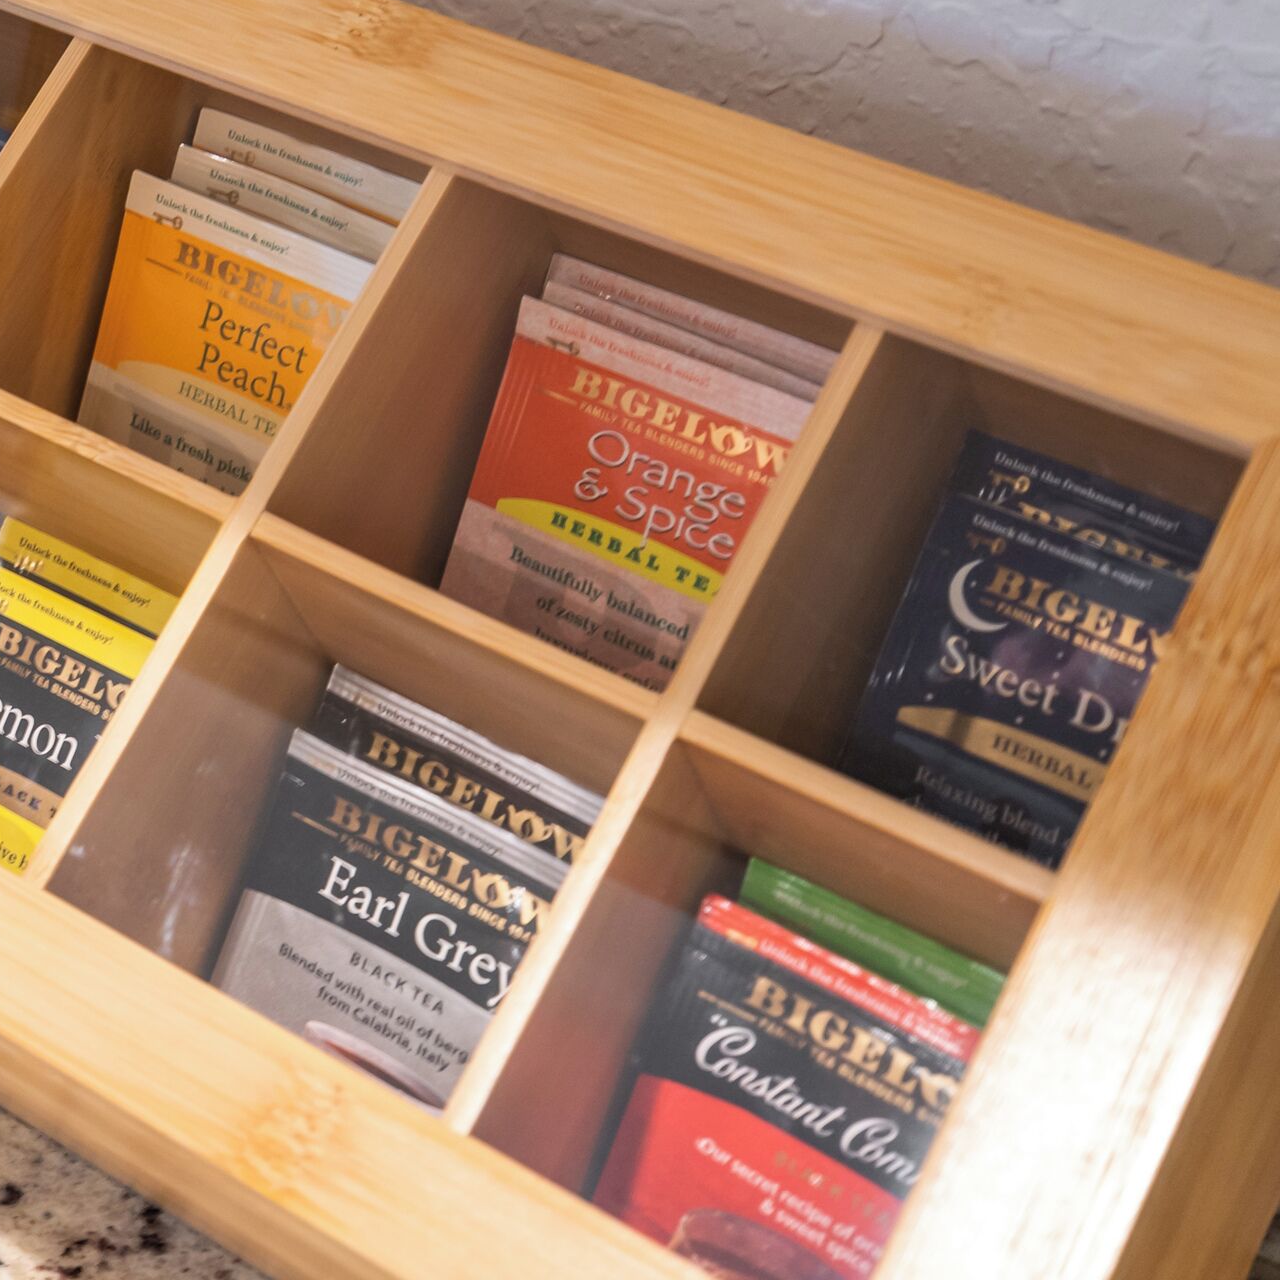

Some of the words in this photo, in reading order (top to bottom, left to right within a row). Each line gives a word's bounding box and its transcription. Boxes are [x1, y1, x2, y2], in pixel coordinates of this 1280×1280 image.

[228, 129, 262, 149] Unlock
[263, 142, 278, 155] the
[279, 147, 325, 172] freshness
[324, 166, 332, 175] &
[334, 171, 364, 187] enjoy!
[155, 193, 189, 213] Unlock
[190, 207, 204, 221] the
[205, 214, 250, 241] freshness
[250, 233, 258, 242] &
[260, 238, 290, 255] enjoy!
[209, 169, 245, 189] Unlock
[247, 183, 263, 195] the
[265, 188, 310, 215] freshness
[310, 208, 318, 218] &
[320, 214, 349, 231] enjoy!
[199, 299, 308, 374] Perfect
[178, 381, 248, 425] HERBAL
[129, 413, 161, 441] Like
[163, 434, 172, 446] a
[175, 435, 214, 467] fresh
[578, 401, 617, 424] FAMILY
[621, 418, 641, 435] TEA
[644, 428, 706, 461] BLENDERS
[708, 454, 745, 477] SINCE
[587, 430, 746, 524] Orange
[1041, 470, 1061, 486] the
[574, 468, 608, 501] &
[615, 486, 735, 559] Spice
[1016, 531, 1037, 547] the
[19, 536, 52, 559] Unlock
[53, 552, 68, 567] the
[68, 561, 112, 590] freshness
[112, 583, 120, 593] &
[121, 588, 152, 608] enjoy!
[551, 511, 660, 571] HERBAL
[674, 566, 720, 596] TE
[17, 592, 32, 606] the
[32, 599, 75, 627] freshness
[76, 620, 83, 630] &
[85, 626, 115, 645] enjoy!
[510, 545, 604, 602] Beautifully
[606, 591, 690, 642] balanced
[536, 596, 554, 614] of
[555, 606, 599, 637] zesty
[603, 626, 655, 662] citrus
[996, 604, 1044, 630] FAMILY
[1045, 621, 1071, 640] TEA
[1072, 633, 1147, 673] BLENDERS
[0, 657, 32, 679] FAMILY
[32, 674, 49, 689] TEA
[50, 683, 101, 716] BLENDERS
[940, 635, 1060, 715] Sweet
[992, 735, 1092, 790] HERBAL
[914, 765, 998, 819] Relaxing
[998, 805, 1061, 845] blend
[340, 833, 380, 861] FAMILY
[383, 854, 404, 875] TEA
[405, 868, 468, 910] BLENDERS
[469, 902, 507, 931] SINCE
[318, 855, 410, 938] Earl
[414, 913, 513, 1008] Grey
[278, 943, 334, 983] Blended
[335, 977, 365, 1004] with
[367, 998, 396, 1020] real
[396, 1013, 416, 1031] oil
[416, 1025, 433, 1041] of
[349, 951, 409, 993] BLACK
[412, 986, 445, 1015] TEA
[316, 985, 350, 1014] from
[352, 1006, 413, 1053] Calabria,
[416, 1042, 450, 1072] Italy
